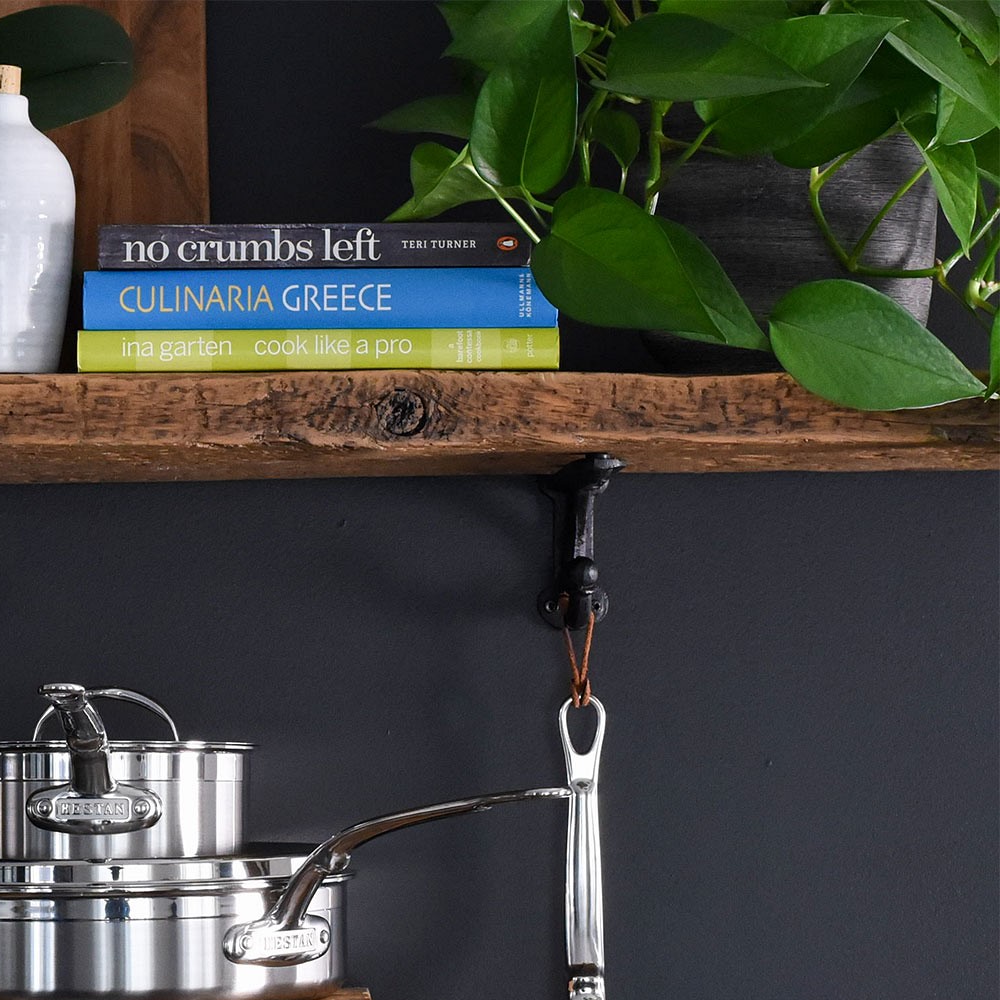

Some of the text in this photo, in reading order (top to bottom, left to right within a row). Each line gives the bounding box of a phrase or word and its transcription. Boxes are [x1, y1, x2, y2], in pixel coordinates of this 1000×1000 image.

[122, 227, 382, 263] no crumbs left
[401, 239, 477, 249] TERI TURNER
[119, 283, 392, 313] CULINARIA GREECE
[121, 336, 232, 362] ina garten
[254, 334, 413, 359] cook like a pro
[60, 804, 126, 816] HESTAN
